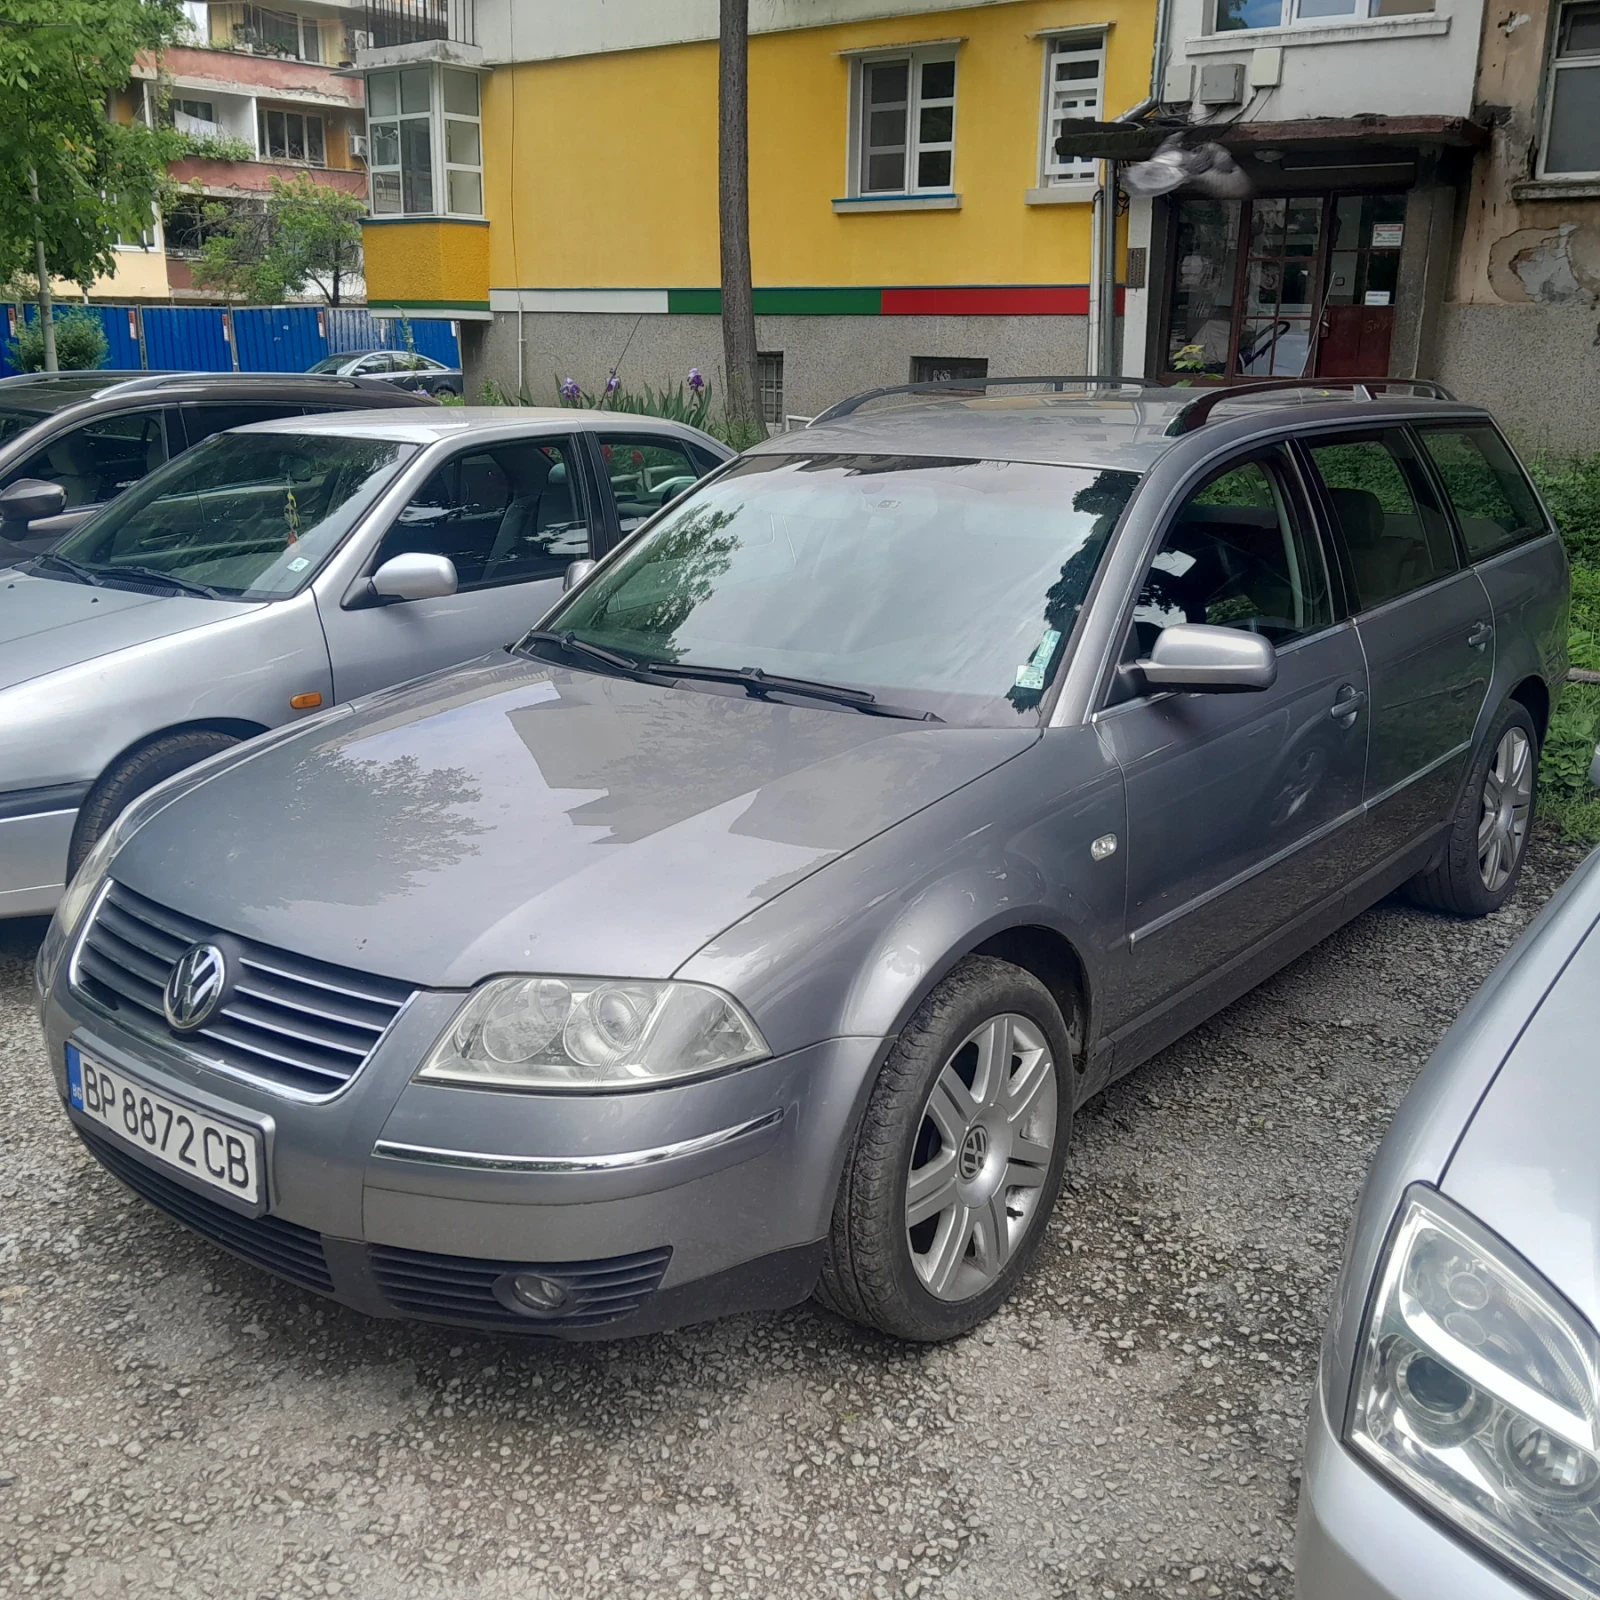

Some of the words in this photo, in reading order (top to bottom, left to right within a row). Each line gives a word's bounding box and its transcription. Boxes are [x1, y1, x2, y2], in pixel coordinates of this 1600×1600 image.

[72, 1083, 83, 1100] BG
[83, 1062, 116, 1119] BP
[122, 1087, 197, 1168] 8872
[203, 1126, 249, 1189] CB
